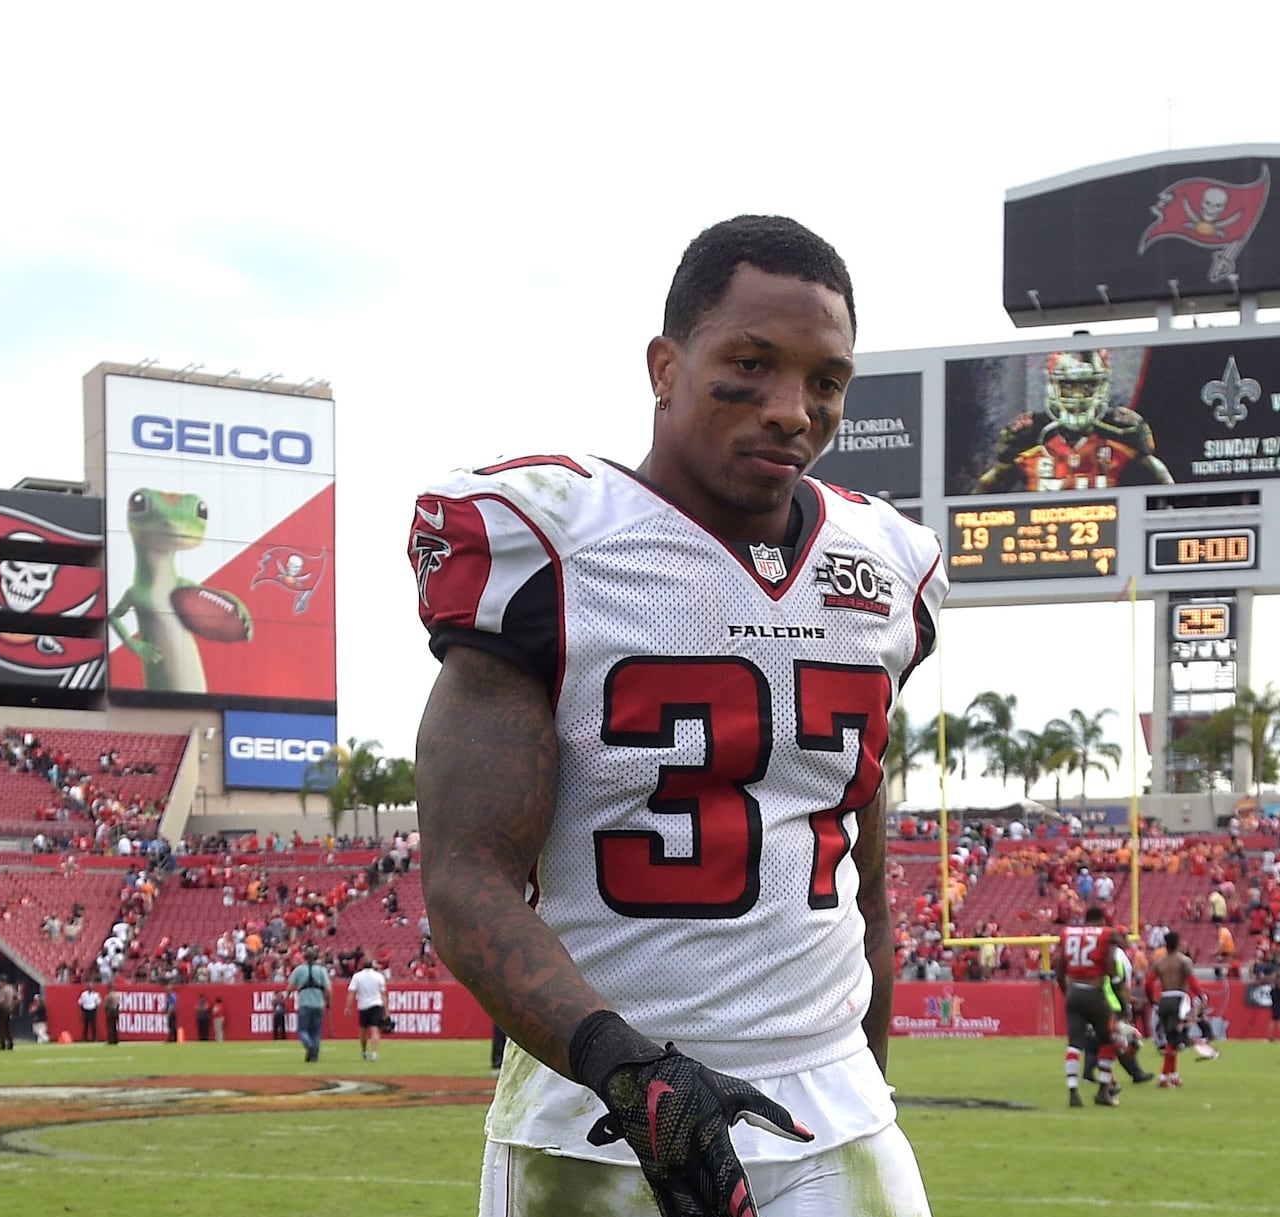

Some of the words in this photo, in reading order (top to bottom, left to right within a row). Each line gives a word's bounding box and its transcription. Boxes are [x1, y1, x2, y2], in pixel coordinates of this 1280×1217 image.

[839, 418, 904, 434] FLORIDA
[132, 414, 312, 465] GEICO
[838, 433, 913, 451] HOSPITAL
[1204, 437, 1260, 458] SUNDAY
[1191, 460, 1232, 475] TICKETS
[1232, 458, 1249, 473] ON
[1250, 457, 1275, 472] SALE
[955, 510, 1016, 528] FALCONS
[1030, 505, 1117, 524] BUCCANEERS
[961, 527, 989, 550] 19
[1070, 522, 1099, 545] 23
[1178, 536, 1248, 564] 0:00
[757, 559, 782, 577] NFL
[831, 556, 878, 600] 50
[728, 624, 825, 639] FALCONS
[1178, 607, 1226, 635] 25
[230, 736, 331, 762] GEICO
[593, 655, 892, 919] 37
[1065, 935, 1097, 967] 92
[388, 991, 443, 1012] SMITH'S
[116, 1013, 169, 1034] OLDIERS
[893, 1015, 938, 1029] Glazer
[952, 1015, 1000, 1032] Family
